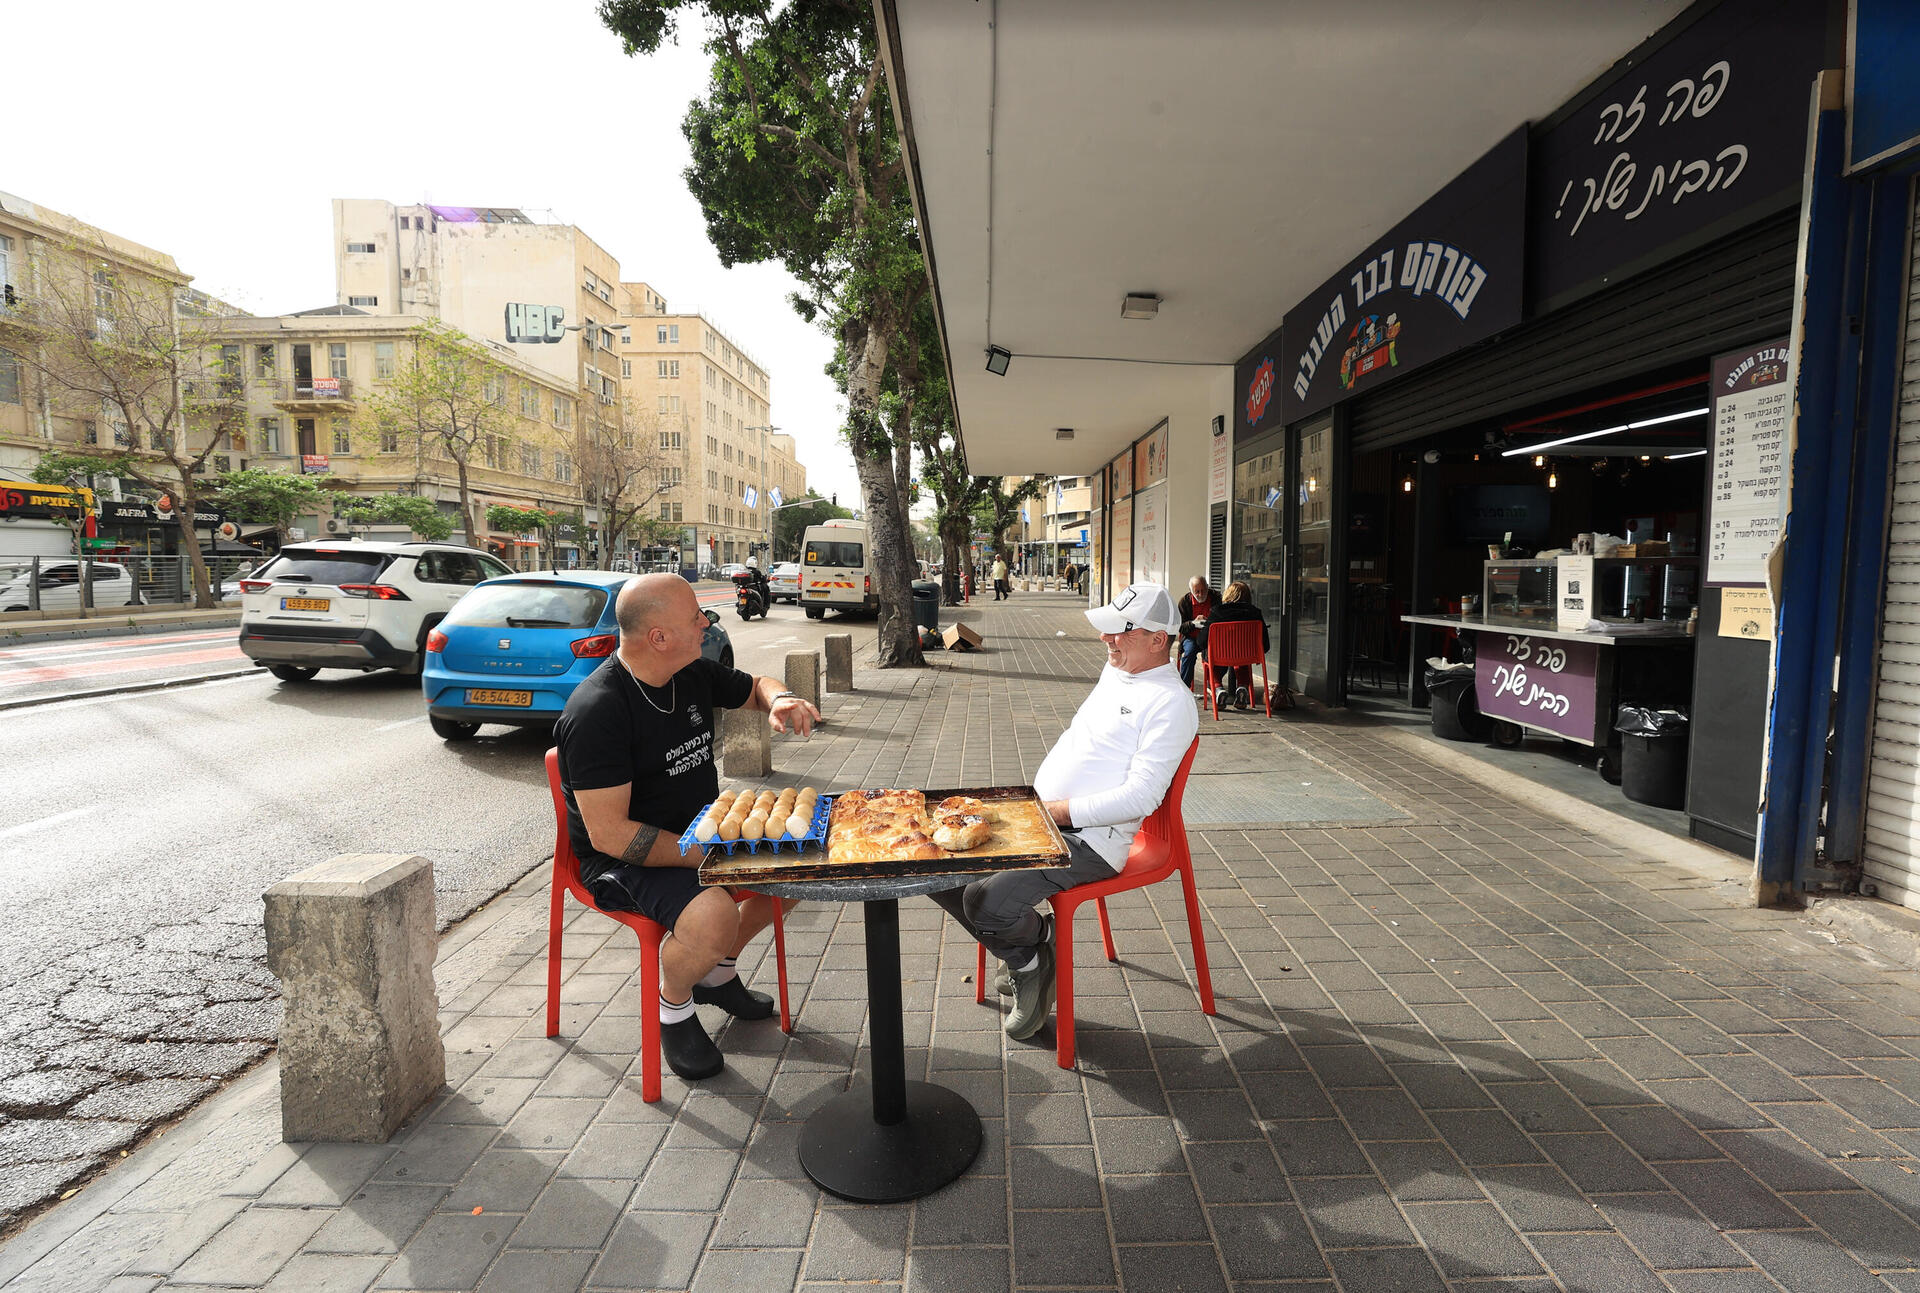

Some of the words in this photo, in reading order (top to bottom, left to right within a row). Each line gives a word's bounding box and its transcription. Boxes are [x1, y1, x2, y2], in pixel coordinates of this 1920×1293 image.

[1659, 60, 1730, 126] פה
[1594, 84, 1647, 145] זה
[1625, 144, 1749, 220] הבית
[1351, 248, 1395, 309] בכר
[1400, 240, 1489, 320] בורקס
[1293, 293, 1346, 402] העגלה
[1757, 348, 1776, 363] בכר
[1725, 356, 1755, 388] העגלה
[1727, 404, 1736, 412] 24
[1758, 396, 1773, 405] גבינה
[1727, 415, 1736, 423] 24
[1757, 408, 1772, 416] גבינה
[1727, 426, 1735, 434] 24
[1726, 437, 1734, 445] 24
[1725, 459, 1733, 467] 24
[114, 508, 148, 518] JAFRA
[183, 512, 220, 521] PRESS
[1722, 520, 1730, 528] 10
[1506, 635, 1531, 661] זה
[1536, 645, 1567, 673] פה
[1519, 683, 1570, 717] הבית
[684, 736, 701, 751] בעיה
[701, 730, 711, 744] אין
